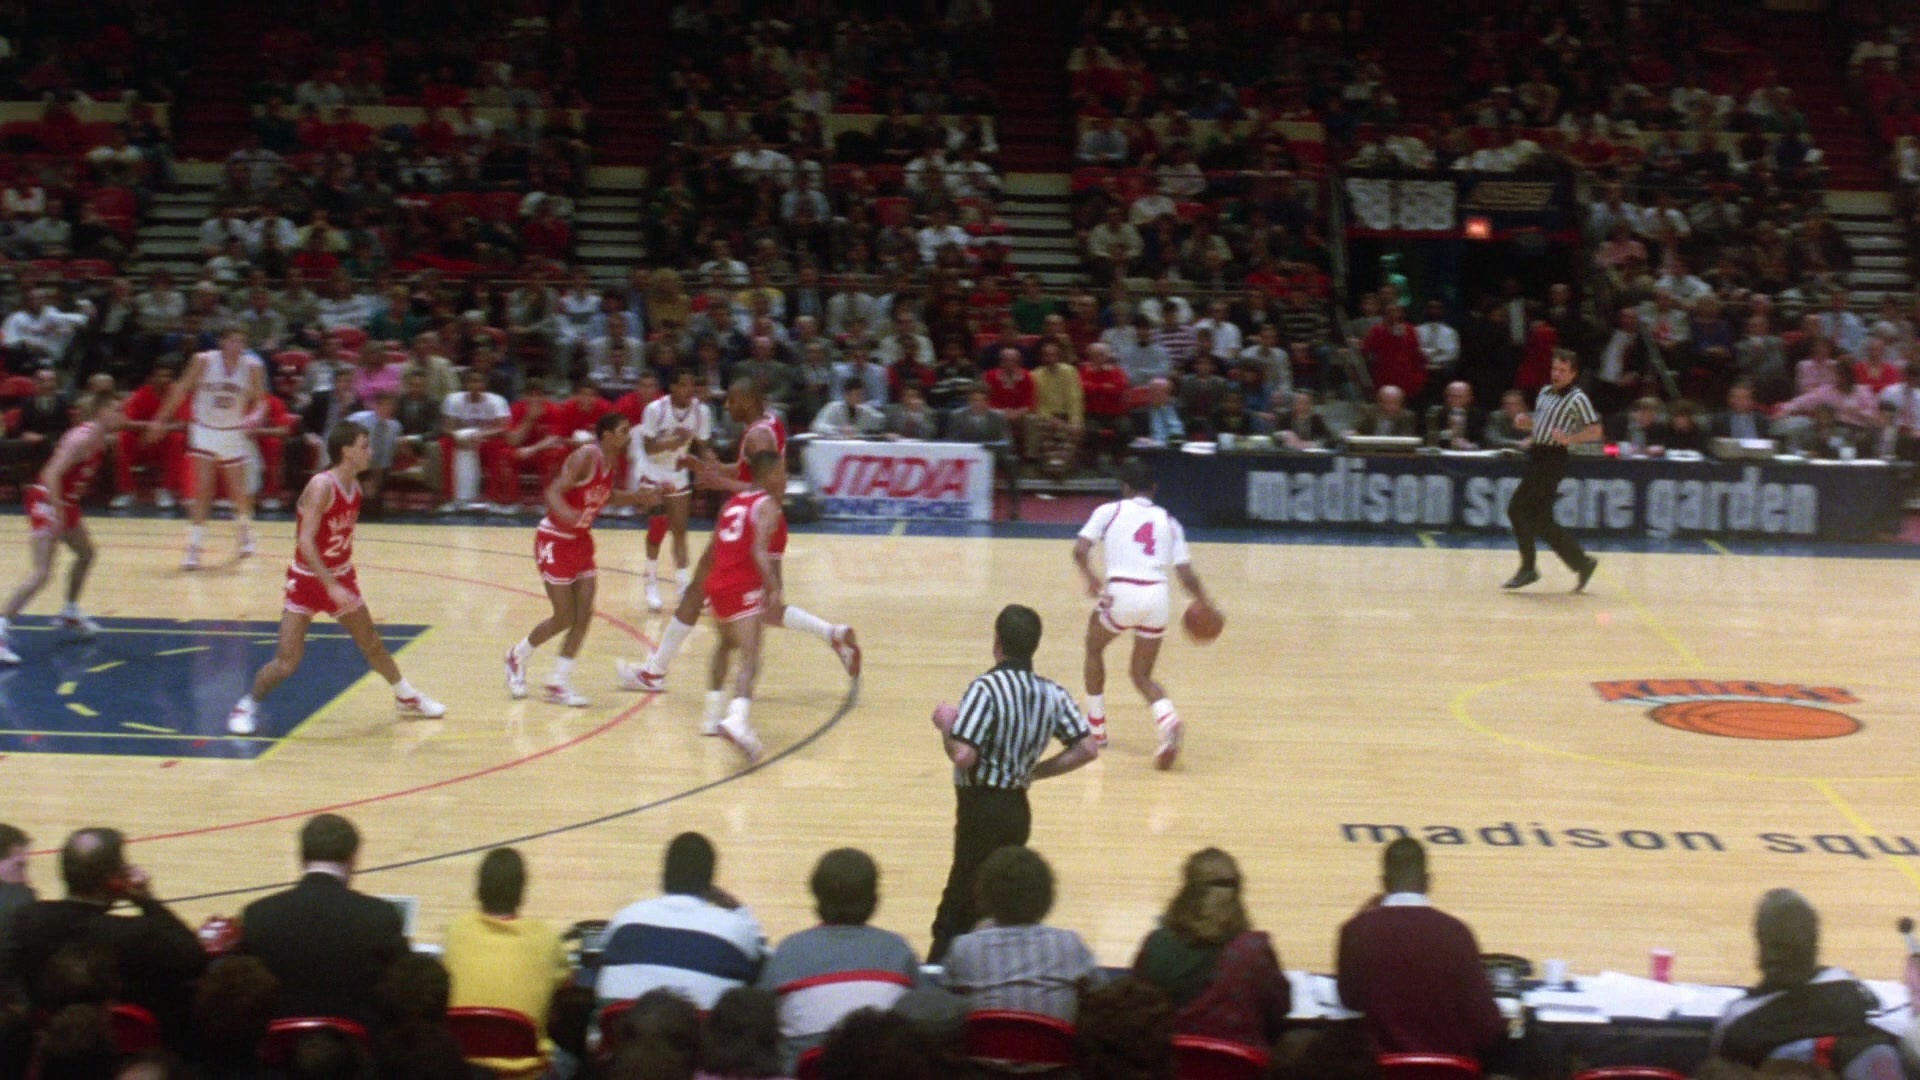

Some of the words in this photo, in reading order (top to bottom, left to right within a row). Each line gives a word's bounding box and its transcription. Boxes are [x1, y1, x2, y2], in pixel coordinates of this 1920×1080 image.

[823, 455, 980, 499] STADIA
[1246, 457, 1454, 525] madison
[1463, 476, 1635, 529] sare
[1646, 467, 1818, 538] garden
[718, 505, 748, 543] 3
[1133, 521, 1156, 556] 4
[1340, 822, 1725, 851] madison
[1757, 832, 1920, 859] squ
